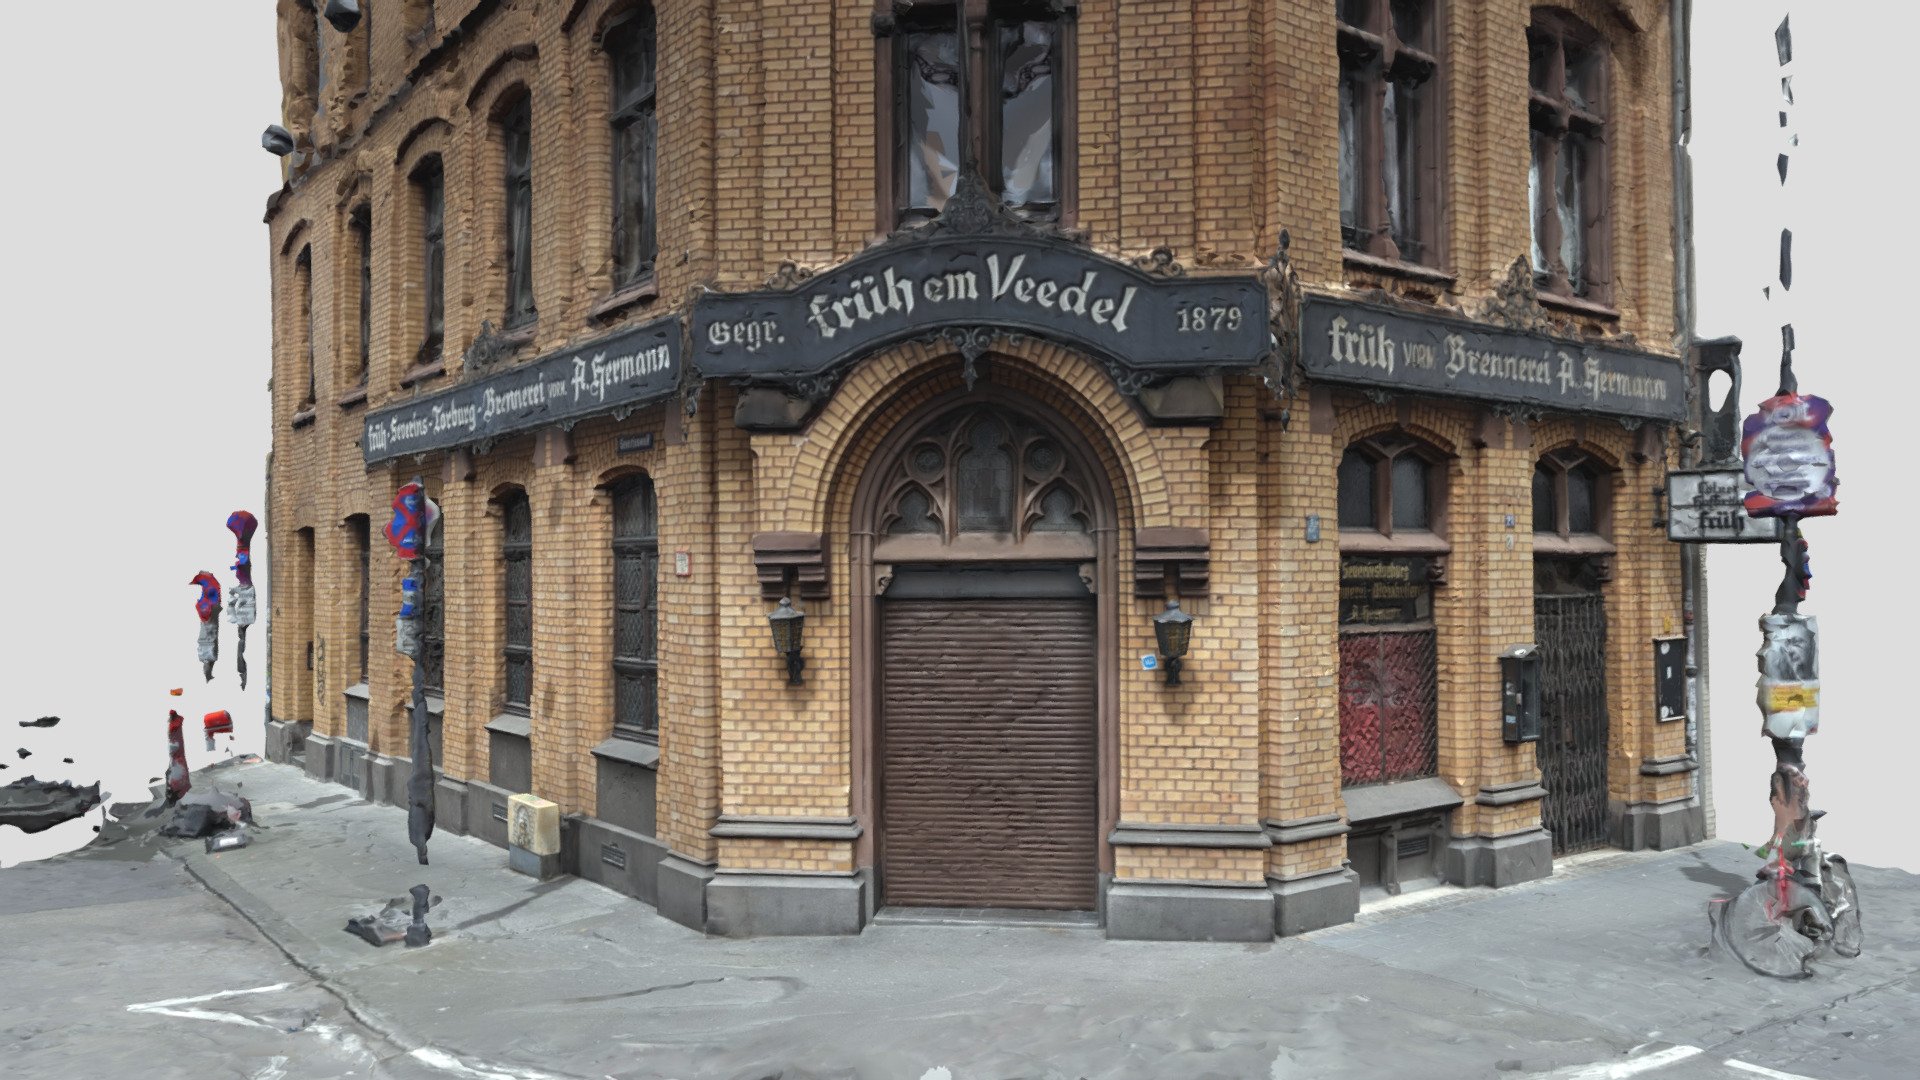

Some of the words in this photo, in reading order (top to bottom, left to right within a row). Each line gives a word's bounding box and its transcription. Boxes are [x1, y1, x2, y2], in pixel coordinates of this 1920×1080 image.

[707, 319, 785, 351] Gegr.
[806, 265, 915, 339] früh
[923, 269, 979, 303] em
[985, 253, 1139, 333] Veedel
[1176, 305, 1243, 332] 1879
[1328, 314, 1395, 376] früh
[1443, 332, 1552, 387] Brennerei
[1699, 509, 1745, 532] früh
